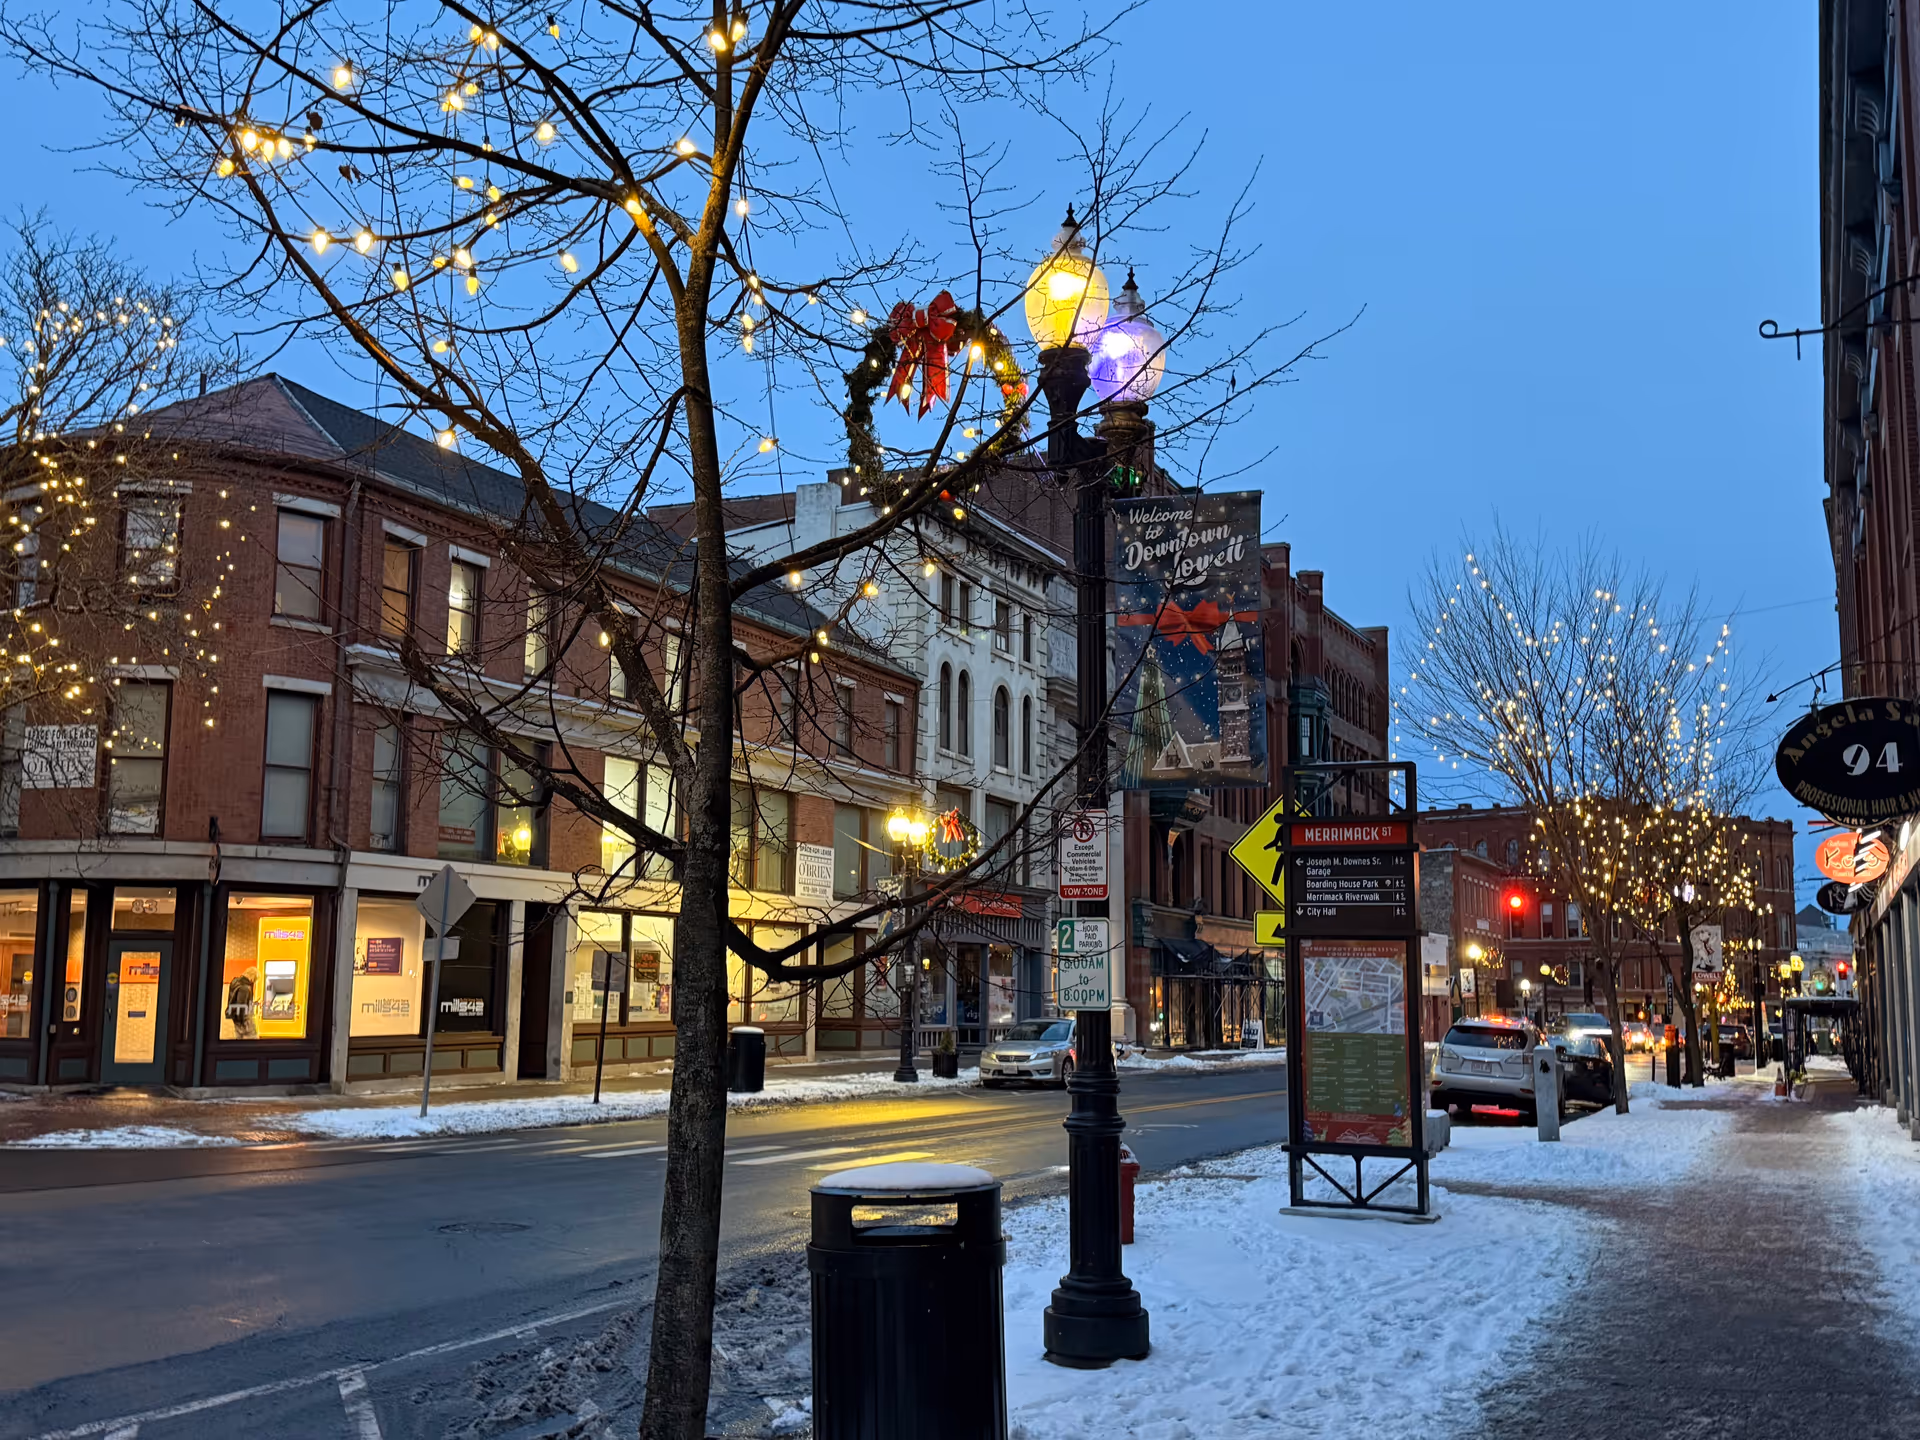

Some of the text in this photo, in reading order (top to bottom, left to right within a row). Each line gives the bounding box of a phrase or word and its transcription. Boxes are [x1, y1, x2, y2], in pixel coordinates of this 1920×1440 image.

[1129, 506, 1193, 524] Welcome
[1145, 525, 1163, 540] to
[1125, 524, 1232, 570] Downtown
[1164, 534, 1245, 587] Lowell
[1783, 704, 1875, 767] Angela
[1842, 741, 1904, 776] 94
[1794, 780, 1868, 817] PROFESSIONAL
[1871, 796, 1898, 816] HAIR
[1899, 794, 1910, 811] &
[1305, 826, 1392, 842] MERRIMACK ST
[1074, 844, 1095, 852] Except
[1307, 856, 1382, 866] Joseph M. Downes Sr.
[798, 861, 832, 880] O'BRIEN
[1306, 867, 1331, 877] Garage
[1306, 879, 1379, 889] Boarding House Park
[1306, 892, 1380, 902] Merrimack Riverwalk
[131, 899, 158, 914] 83
[1307, 907, 1337, 917] City Hall
[263, 928, 305, 939] mills42
[1061, 924, 1072, 949] 2
[1079, 940, 1103, 948] PARKING
[1064, 957, 1104, 970] 8:00AM
[1079, 973, 1089, 985] to
[1064, 989, 1105, 1002] 8:00PM
[361, 998, 410, 1014] mills42
[440, 998, 485, 1014] mills42
